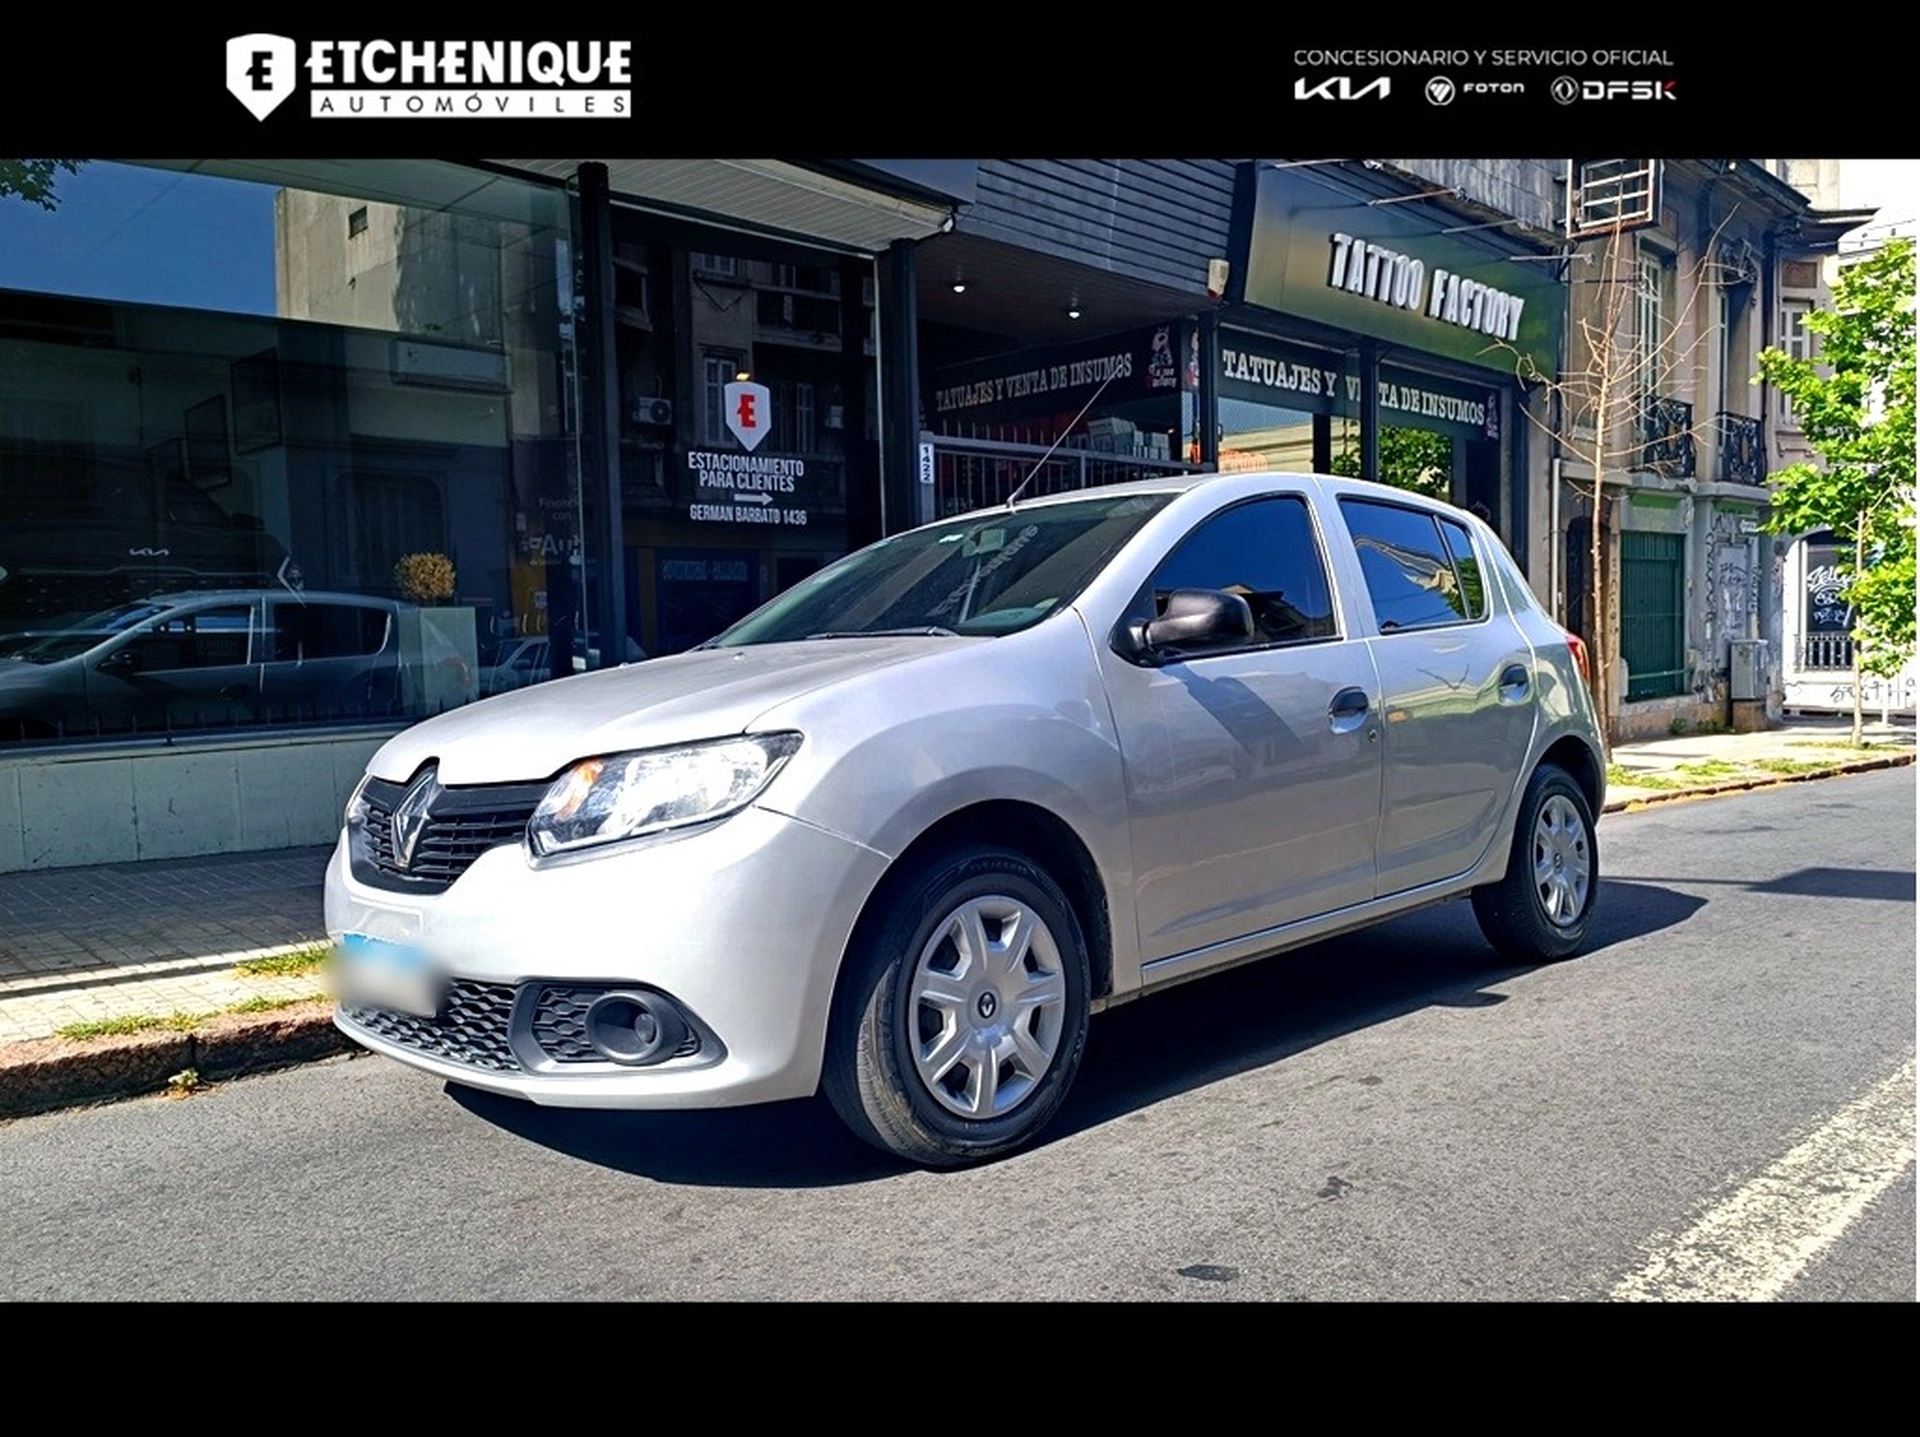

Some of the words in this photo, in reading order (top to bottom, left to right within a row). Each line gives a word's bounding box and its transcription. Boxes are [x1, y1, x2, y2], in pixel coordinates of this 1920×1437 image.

[1327, 232, 1425, 311] TATTOO
[1424, 268, 1525, 341] FACTORY
[935, 385, 994, 412] TATUAJES
[995, 381, 1004, 401] Y
[1005, 367, 1048, 399] VENTA
[1049, 364, 1068, 391] DE
[1069, 352, 1133, 387] INSUMOS
[1222, 349, 1321, 395] TATUAJES
[1324, 372, 1338, 397] Y
[1401, 387, 1421, 413] DE
[1421, 391, 1486, 426] INSUMOS
[688, 451, 804, 477] ESTACIONAMIENTO
[922, 446, 931, 481] 1422
[699, 470, 735, 489] PARA
[736, 473, 795, 493] CLIENTES
[690, 504, 733, 522] GERMAN
[735, 506, 781, 524] BARBATO
[782, 509, 807, 525] 1436
